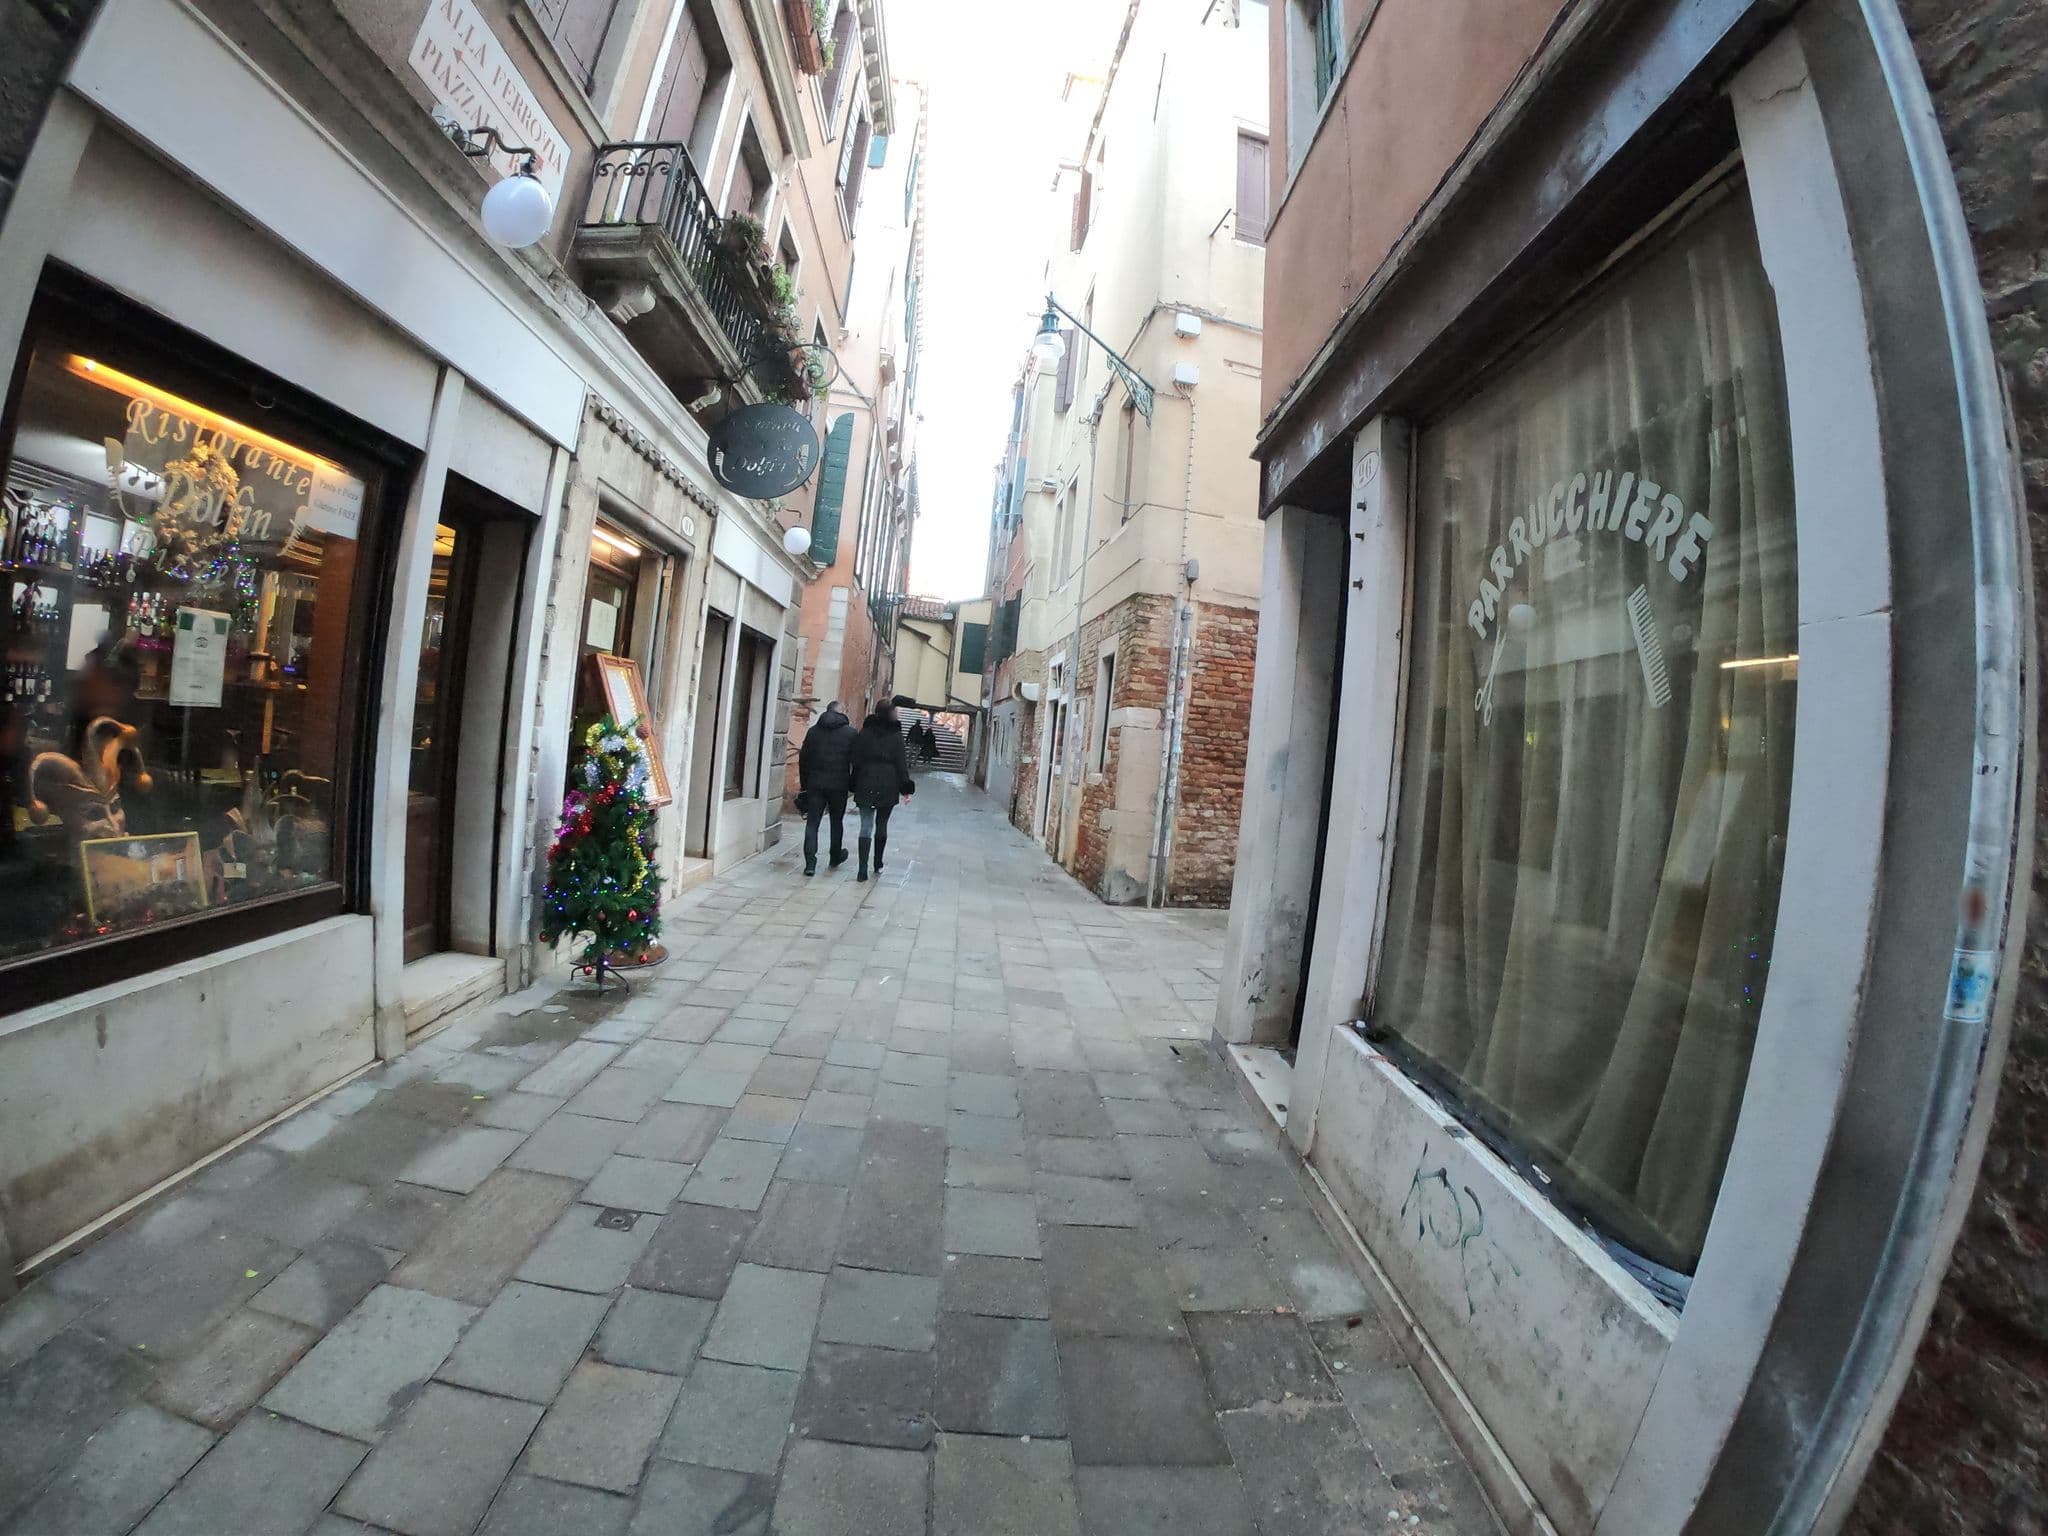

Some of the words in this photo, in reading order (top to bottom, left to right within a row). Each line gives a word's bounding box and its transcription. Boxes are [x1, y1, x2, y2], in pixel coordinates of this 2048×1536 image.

[421, 37, 504, 155] PIAZZAL
[439, 0, 486, 67] ALLA
[493, 65, 562, 174] FERROVIA
[126, 398, 311, 496] Ristorante
[159, 468, 273, 541] Dolfin
[1468, 469, 1714, 640] PARRUCCHIERE
